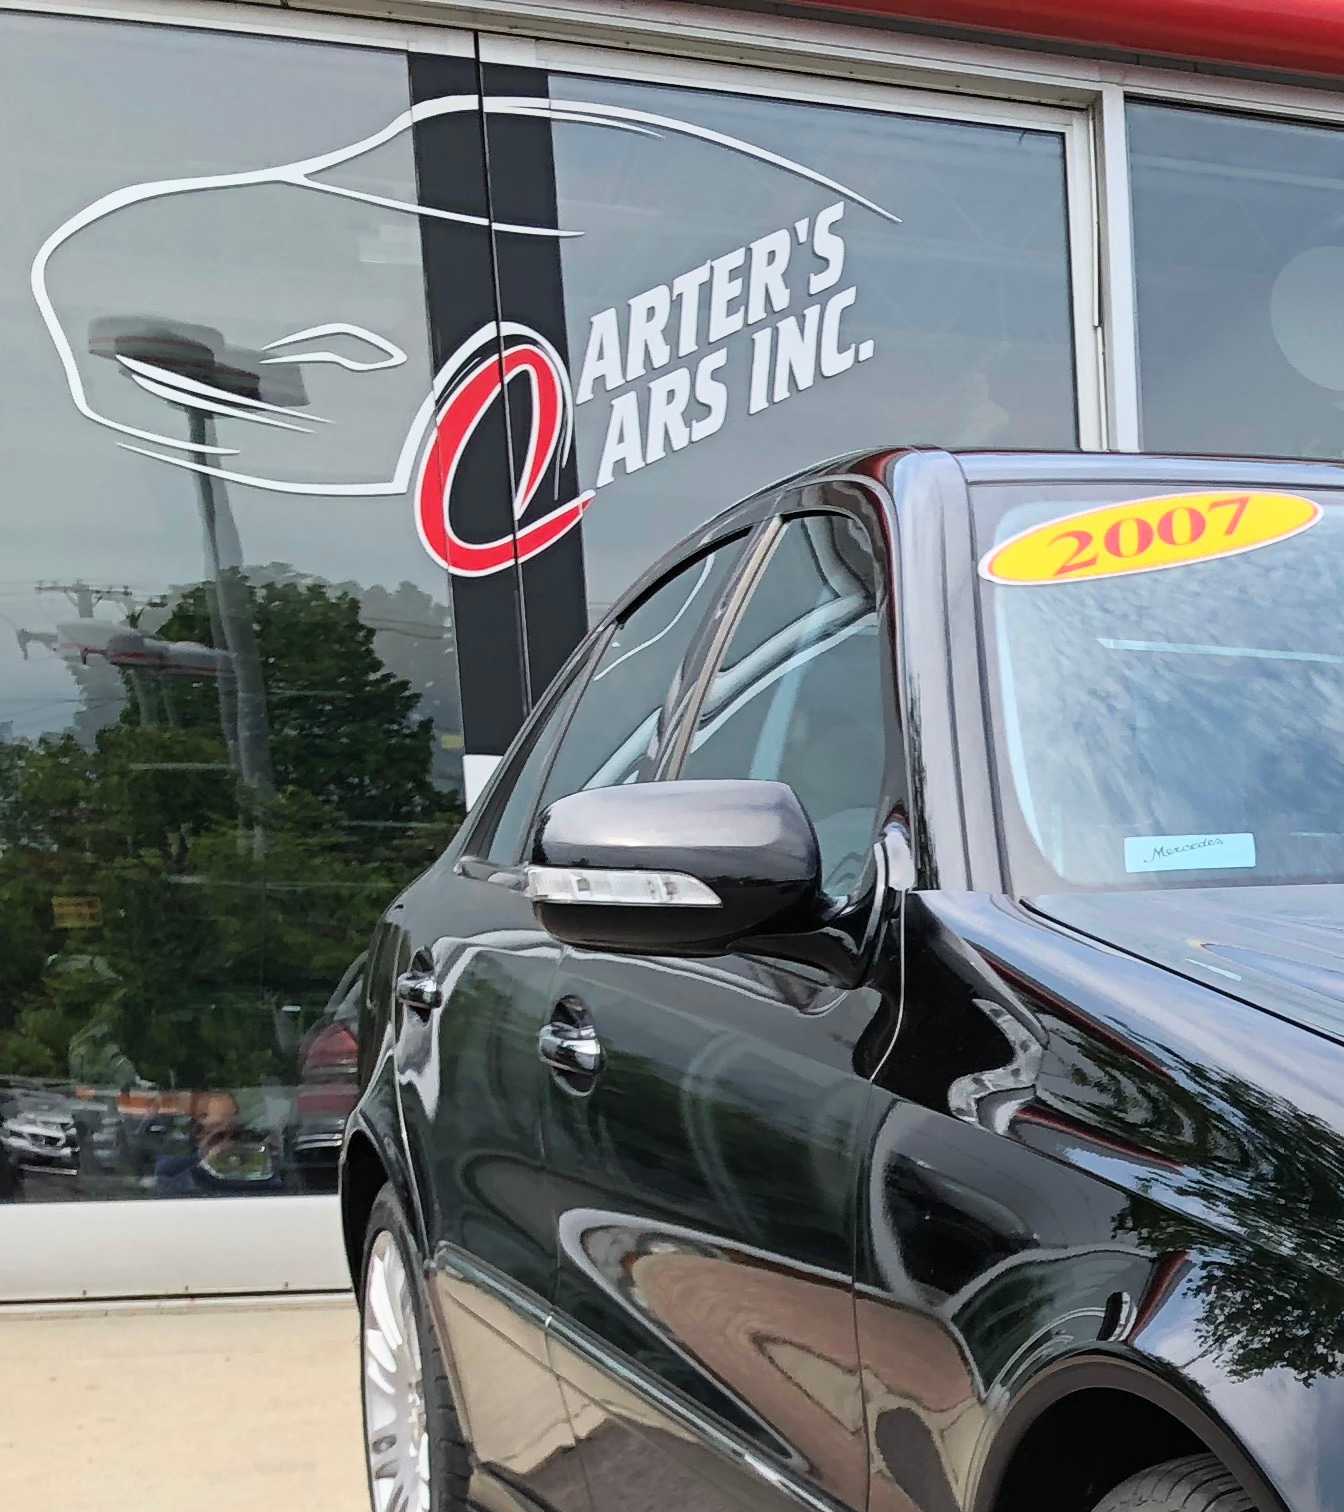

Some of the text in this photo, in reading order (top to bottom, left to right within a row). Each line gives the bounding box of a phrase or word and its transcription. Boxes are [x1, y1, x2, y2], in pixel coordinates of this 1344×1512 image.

[748, 286, 875, 416] INC.
[1048, 495, 1252, 578] 2007
[1143, 837, 1225, 864] Mercedes
